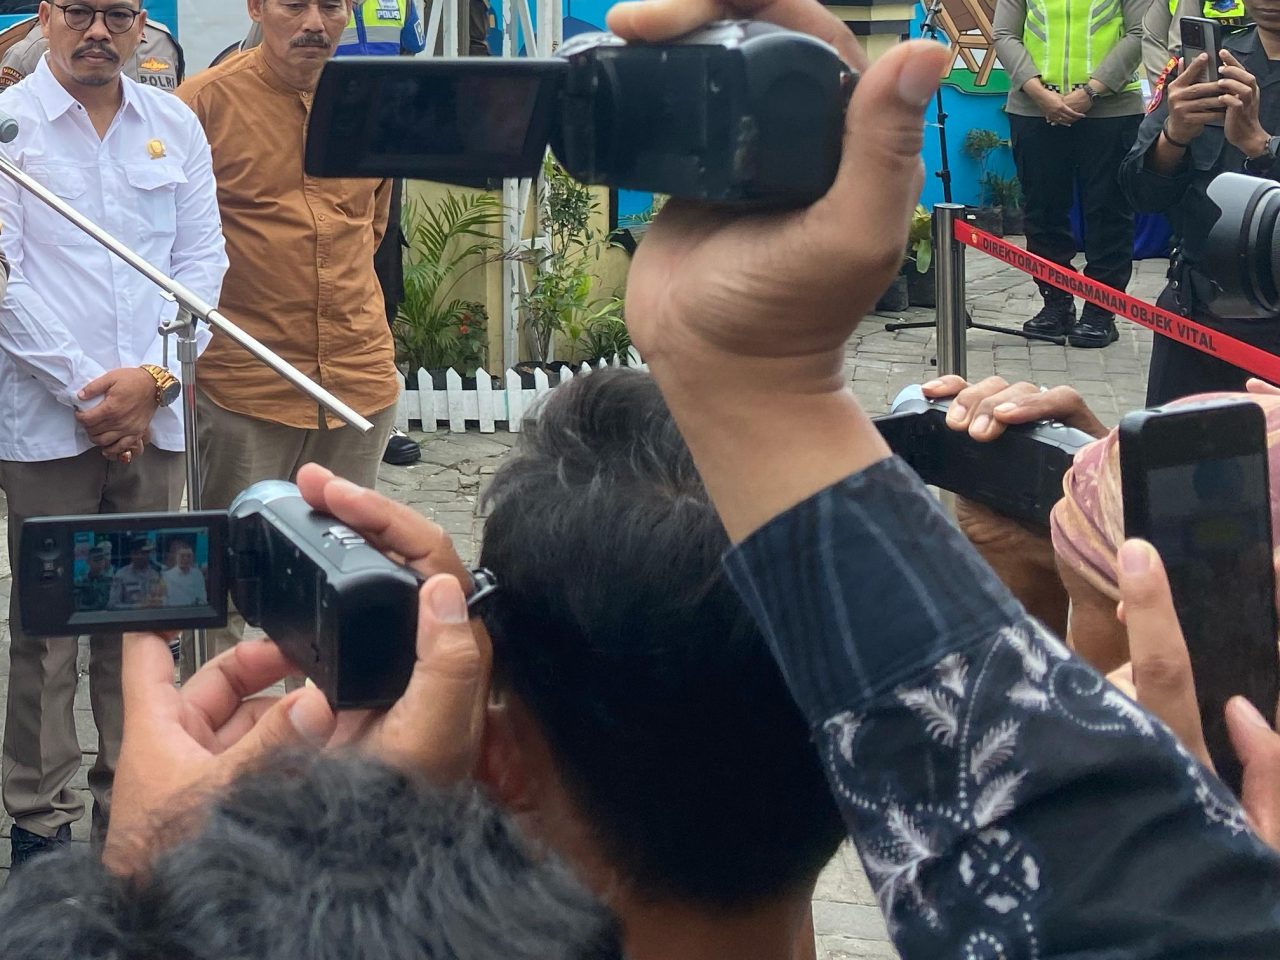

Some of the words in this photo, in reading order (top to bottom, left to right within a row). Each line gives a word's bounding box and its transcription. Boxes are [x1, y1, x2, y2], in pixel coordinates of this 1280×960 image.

[140, 74, 175, 89] POLRI
[983, 237, 1046, 277] DIREKTORAT
[1048, 268, 1127, 314] PENGAMANAN
[1130, 303, 1173, 333] OBJEK
[1177, 320, 1217, 351] VITAL
